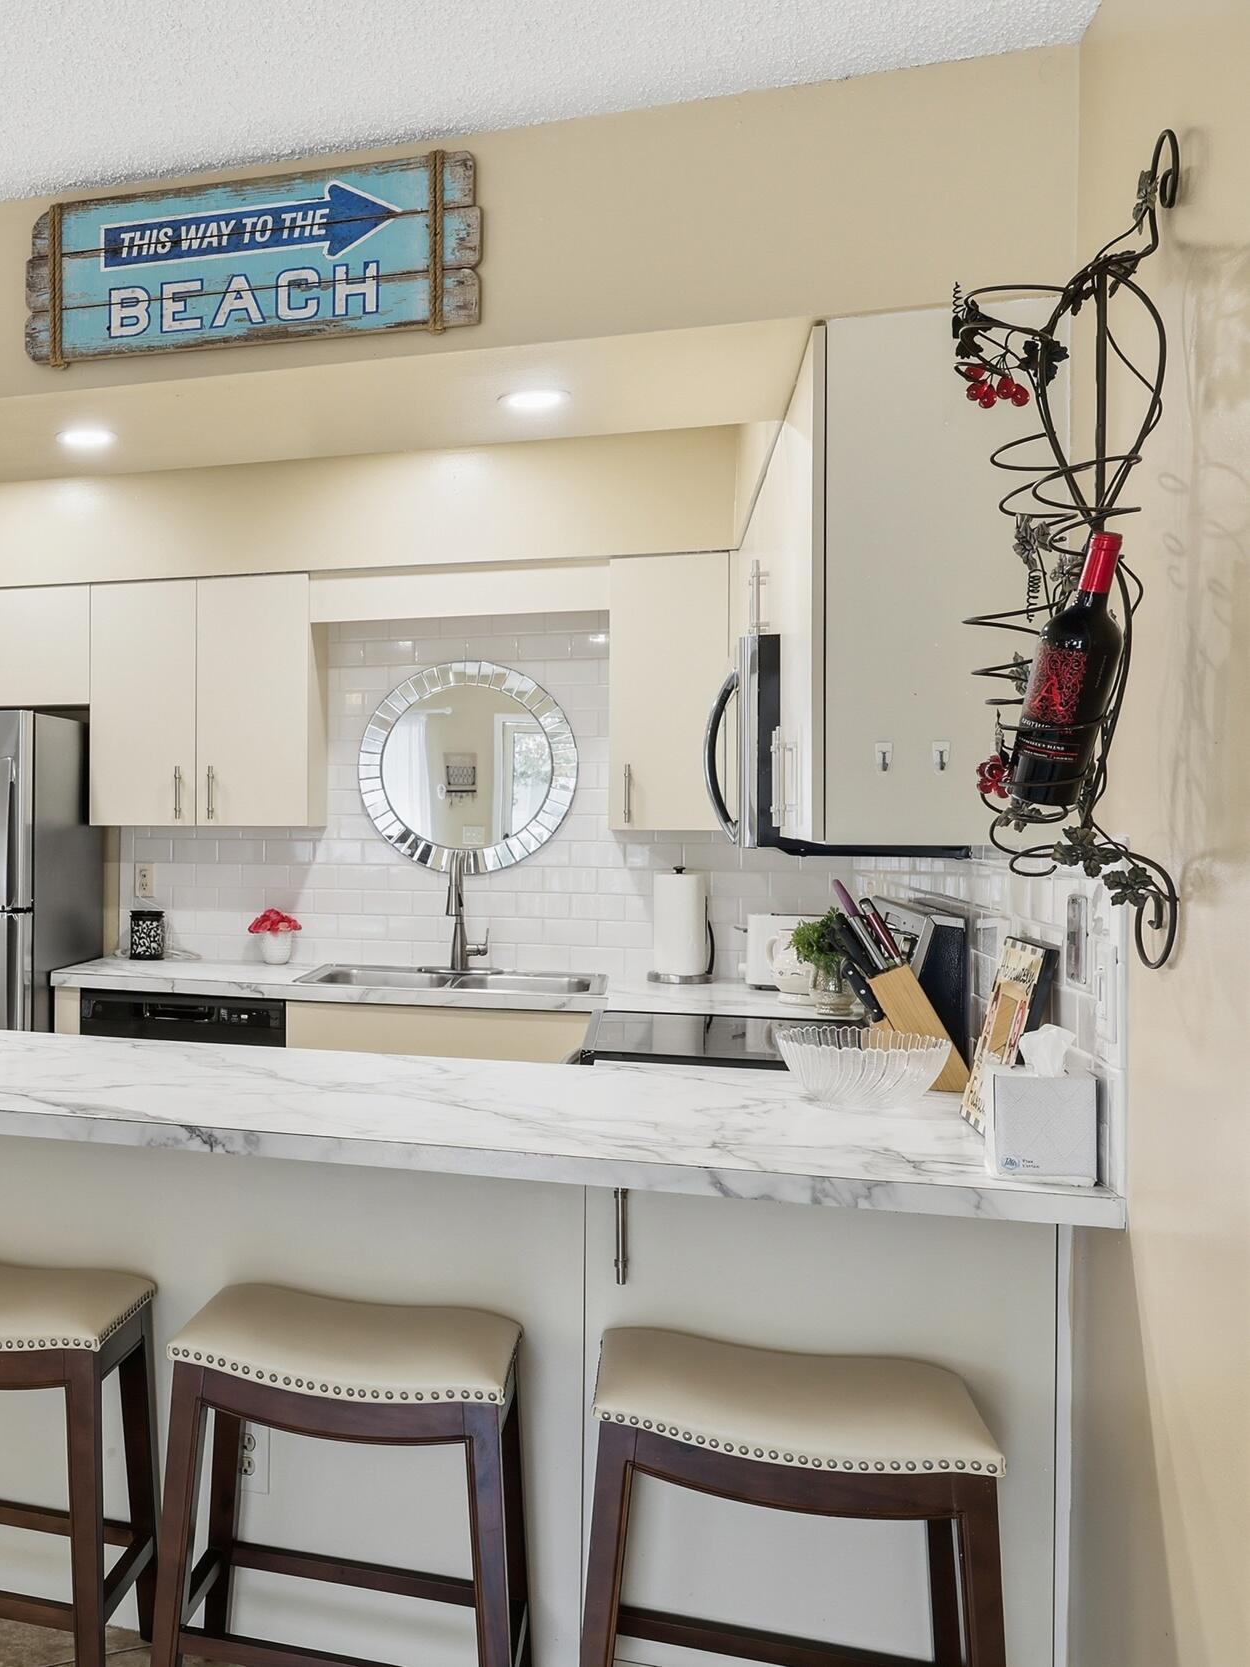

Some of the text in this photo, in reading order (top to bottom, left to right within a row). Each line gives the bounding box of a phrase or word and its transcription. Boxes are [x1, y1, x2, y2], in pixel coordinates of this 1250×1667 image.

[120, 208, 330, 258] THIS WAY TO THE
[108, 260, 380, 339] BEACH
